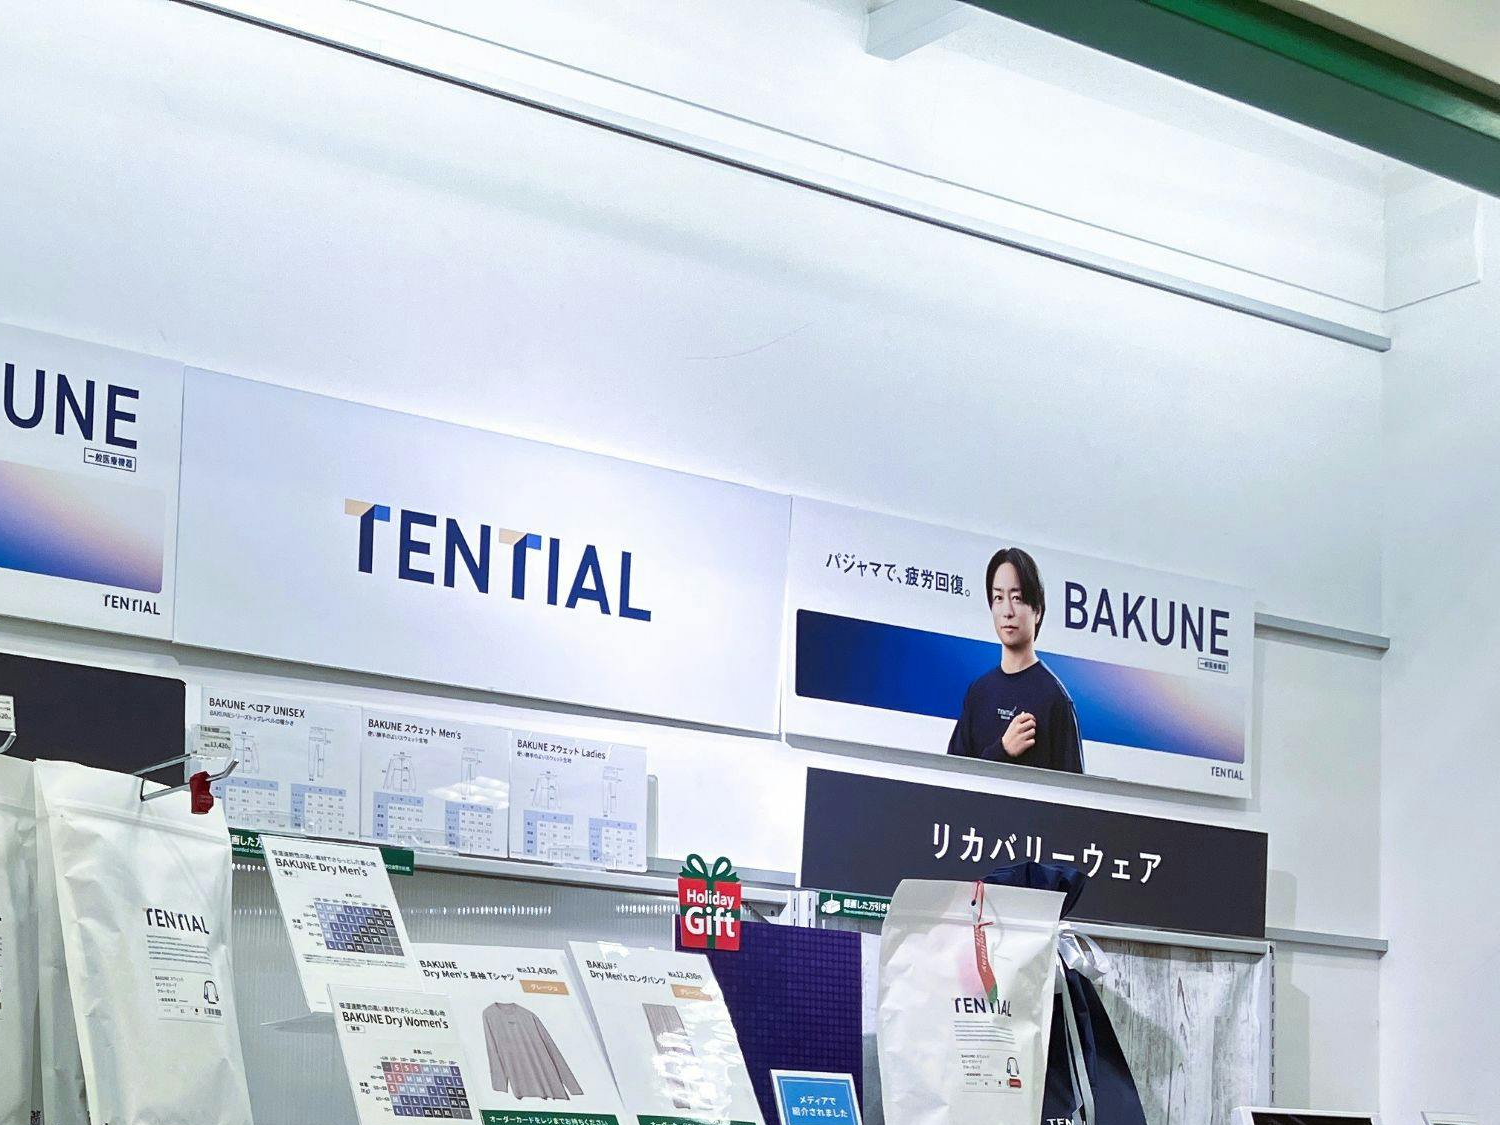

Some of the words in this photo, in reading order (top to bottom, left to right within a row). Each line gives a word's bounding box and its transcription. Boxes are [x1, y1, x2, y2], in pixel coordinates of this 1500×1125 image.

[345, 498, 651, 622] TENTIAL
[825, 552, 971, 598] パジャマで、疲労回復。
[102, 594, 161, 615] TENTIAL
[1064, 581, 1230, 657] BAKUNE
[209, 697, 245, 713] BAKUNE
[248, 703, 270, 714] ベロア
[273, 706, 305, 719] UNISEX
[368, 718, 402, 733] BAKUNE
[404, 723, 436, 736] スウェット
[439, 728, 461, 740] Men's
[517, 738, 548, 752] BAKUNE
[551, 744, 579, 756] スウェット
[581, 747, 606, 760] Ladies
[1211, 766, 1244, 781] TENTIAL
[931, 822, 1162, 883] リカバリーウェア
[275, 858, 317, 872] BAKUNE
[318, 863, 337, 876] Dry
[339, 865, 368, 878] Men's
[686, 889, 734, 906] Holiday
[142, 907, 210, 934] TENTIAL
[685, 907, 735, 938] Gift
[420, 960, 457, 969] BAKUNE
[423, 970, 441, 979] Dry
[442, 970, 468, 980] Men's
[590, 971, 604, 980] Dry
[606, 972, 628, 982] Men's
[342, 1011, 383, 1025] BAKUNE
[386, 1014, 403, 1028] Dry
[404, 1016, 449, 1030] Women's
[792, 1107, 848, 1118] 紹介されました
